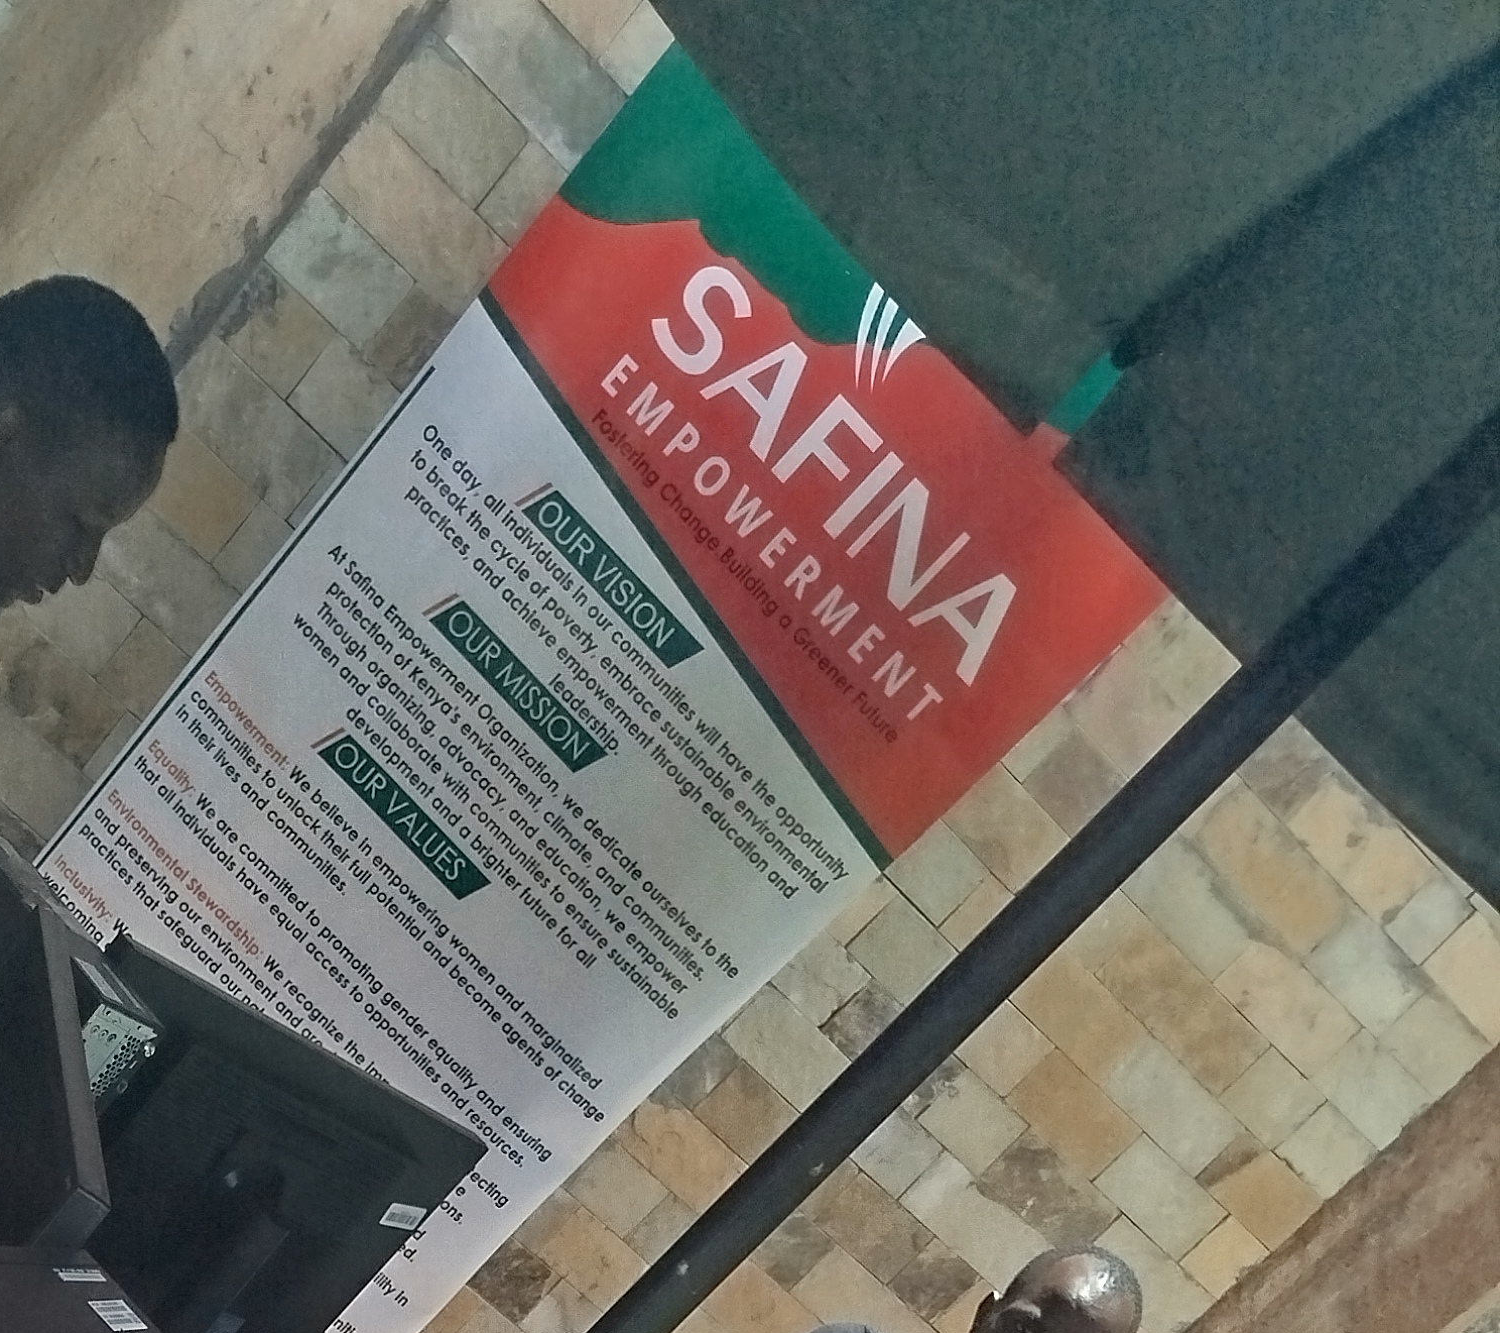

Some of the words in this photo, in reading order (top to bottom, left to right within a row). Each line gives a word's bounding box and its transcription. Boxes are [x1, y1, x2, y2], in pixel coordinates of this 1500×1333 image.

[422, 424, 452, 461] One
[451, 459, 482, 497] day,
[483, 493, 507, 517] all
[500, 508, 574, 591] individuals
[571, 584, 588, 607] in
[586, 605, 614, 631] our
[610, 630, 696, 722] communities
[694, 717, 722, 746] will
[715, 740, 753, 783] have
[750, 777, 776, 807] the
[774, 806, 849, 881] opportunity
[538, 500, 595, 566] OUR
[592, 553, 675, 648] VISION
[591, 406, 660, 489] Fostering
[778, 613, 792, 630] a
[792, 626, 854, 694] Greener
[850, 689, 897, 743] Future
[600, 353, 943, 720] EMPOWERMENT
[650, 264, 1016, 686] SAFINA
[174, 702, 189, 723] in
[186, 717, 216, 752] their
[212, 747, 241, 783] lives
[239, 781, 270, 811] and
[266, 809, 346, 896] communities.
[293, 612, 340, 668] women
[338, 665, 371, 697] and
[366, 695, 442, 774] collaborate
[441, 771, 470, 804] with
[468, 802, 551, 889] communities
[548, 883, 565, 903] to
[564, 903, 608, 949] ensure
[606, 947, 678, 1019] sustainable
[316, 600, 367, 662] Through
[366, 660, 437, 738] organizing,
[437, 735, 507, 812] advocacy,
[508, 808, 540, 839] and
[535, 837, 601, 913] education,
[604, 908, 626, 933] we
[625, 932, 688, 994] empower
[324, 581, 394, 655] protection
[393, 652, 413, 671] of
[407, 665, 461, 724] Kenya's
[459, 722, 543, 813] environment,
[542, 810, 592, 868] climate,
[594, 865, 627, 896] and
[622, 895, 704, 982] communities.
[326, 544, 348, 566] At
[343, 559, 385, 609] Safina
[382, 603, 481, 707] Empowerment
[477, 702, 559, 798] Organization,
[561, 793, 584, 819] we
[582, 817, 642, 881] dedicate
[641, 880, 703, 943] ourselves
[699, 937, 717, 957] to
[714, 952, 738, 979] the
[334, 742, 387, 799] OUR
[386, 789, 466, 880] VALUES
[345, 707, 435, 799] development
[430, 796, 463, 827] and
[458, 825, 472, 839] a
[469, 833, 522, 891] brighter
[518, 886, 557, 930] future
[555, 925, 578, 949] for
[575, 948, 597, 969] all
[403, 484, 470, 560] practices,
[472, 557, 506, 590] and
[501, 587, 557, 647] achieve
[555, 646, 655, 749] empowerment
[649, 743, 703, 803] through
[700, 801, 768, 873] education
[766, 870, 800, 899] and
[409, 448, 426, 471] to
[424, 464, 468, 517] break
[464, 508, 490, 540] the
[489, 538, 530, 582] cycle
[528, 580, 550, 599] of
[540, 595, 598, 659] poverty,
[599, 656, 662, 723] embrace
[659, 720, 735, 800] sustainable
[733, 799, 829, 894] environmental
[448, 610, 501, 669] OUR
[494, 661, 590, 760] MISSION
[548, 672, 619, 755] leadership.
[53, 853, 113, 923] Inclusivity:
[113, 918, 133, 939] W
[77, 822, 134, 885] practices
[131, 879, 160, 912] that
[156, 909, 223, 974] safeguard
[217, 971, 244, 999] our
[93, 807, 121, 836] and
[113, 833, 179, 904] preserving
[178, 901, 203, 924] our
[200, 923, 279, 1002] environment
[272, 995, 306, 1031] and
[107, 787, 190, 882] Environmental
[185, 877, 263, 960] Stewardship:
[263, 953, 284, 981] We
[282, 978, 344, 1043] recognize
[341, 1037, 370, 1067] the
[133, 754, 161, 786] that
[156, 784, 177, 804] all
[171, 798, 237, 872] individuals
[234, 865, 269, 905] have
[268, 903, 309, 944] equal
[304, 941, 350, 989] access
[348, 984, 363, 1003] to
[363, 1002, 441, 1083] opportunities
[439, 1081, 470, 1110] and
[464, 1107, 524, 1168] resources.
[147, 738, 196, 797] Equality:
[195, 791, 216, 820] We
[215, 818, 238, 844] are
[238, 842, 309, 913] committed
[304, 907, 320, 927] to
[316, 925, 384, 995] promoting
[379, 991, 430, 1039] gender
[426, 1037, 479, 1090] equality
[475, 1088, 506, 1117] and
[501, 1115, 552, 1162] ensuring
[190, 690, 262, 774] communities
[260, 768, 276, 789] to
[275, 786, 322, 835] unlock
[319, 828, 351, 863] their
[347, 858, 372, 885] full
[364, 881, 427, 942] potential
[422, 939, 453, 969] and
[447, 963, 502, 1023] become
[500, 1021, 545, 1067] agents
[543, 1065, 563, 1081] of
[557, 1079, 604, 1122] change
[204, 669, 290, 770] Empowerment:
[288, 763, 311, 793] We
[309, 787, 359, 842] believe
[357, 836, 372, 857] in
[371, 854, 450, 938] empowering
[448, 933, 496, 985] women
[494, 983, 525, 1012] and
[519, 1009, 603, 1090] marginalized
[392, 1289, 411, 1309] in
